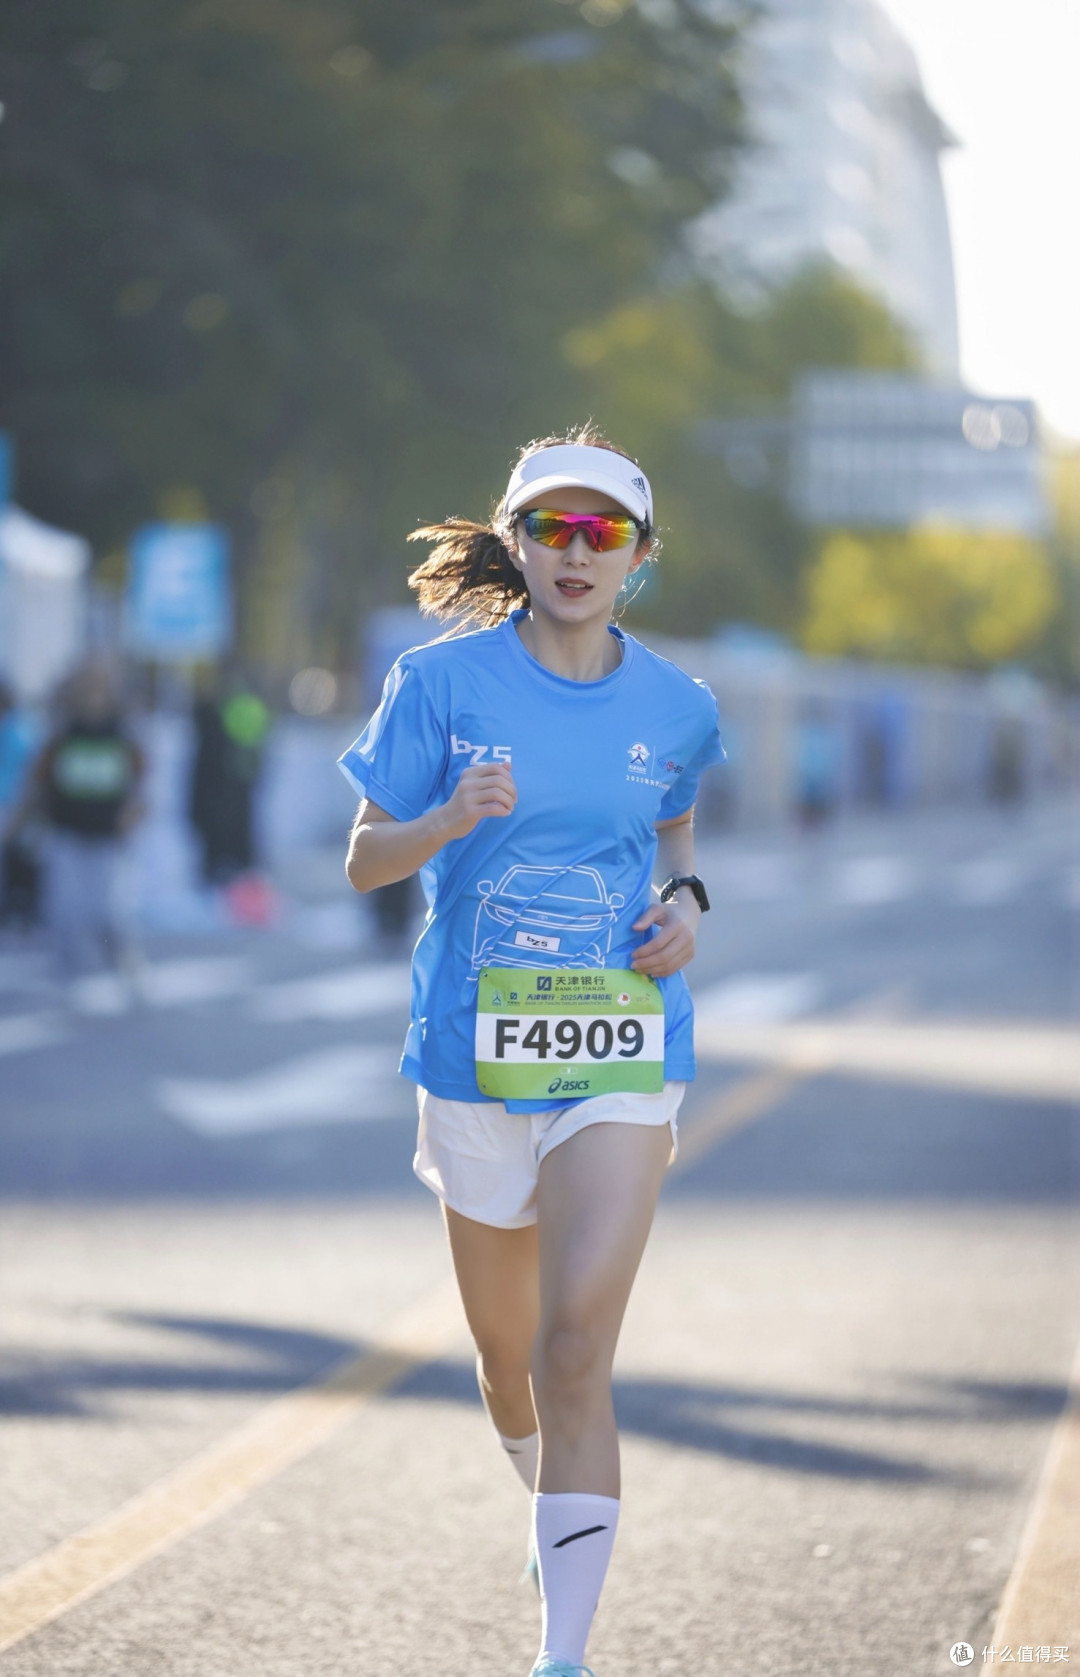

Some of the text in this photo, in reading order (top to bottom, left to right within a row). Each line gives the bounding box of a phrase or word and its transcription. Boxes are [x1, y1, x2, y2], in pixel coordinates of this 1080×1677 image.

[555, 975, 606, 986] 天津银行
[495, 1018, 645, 1060] F4909
